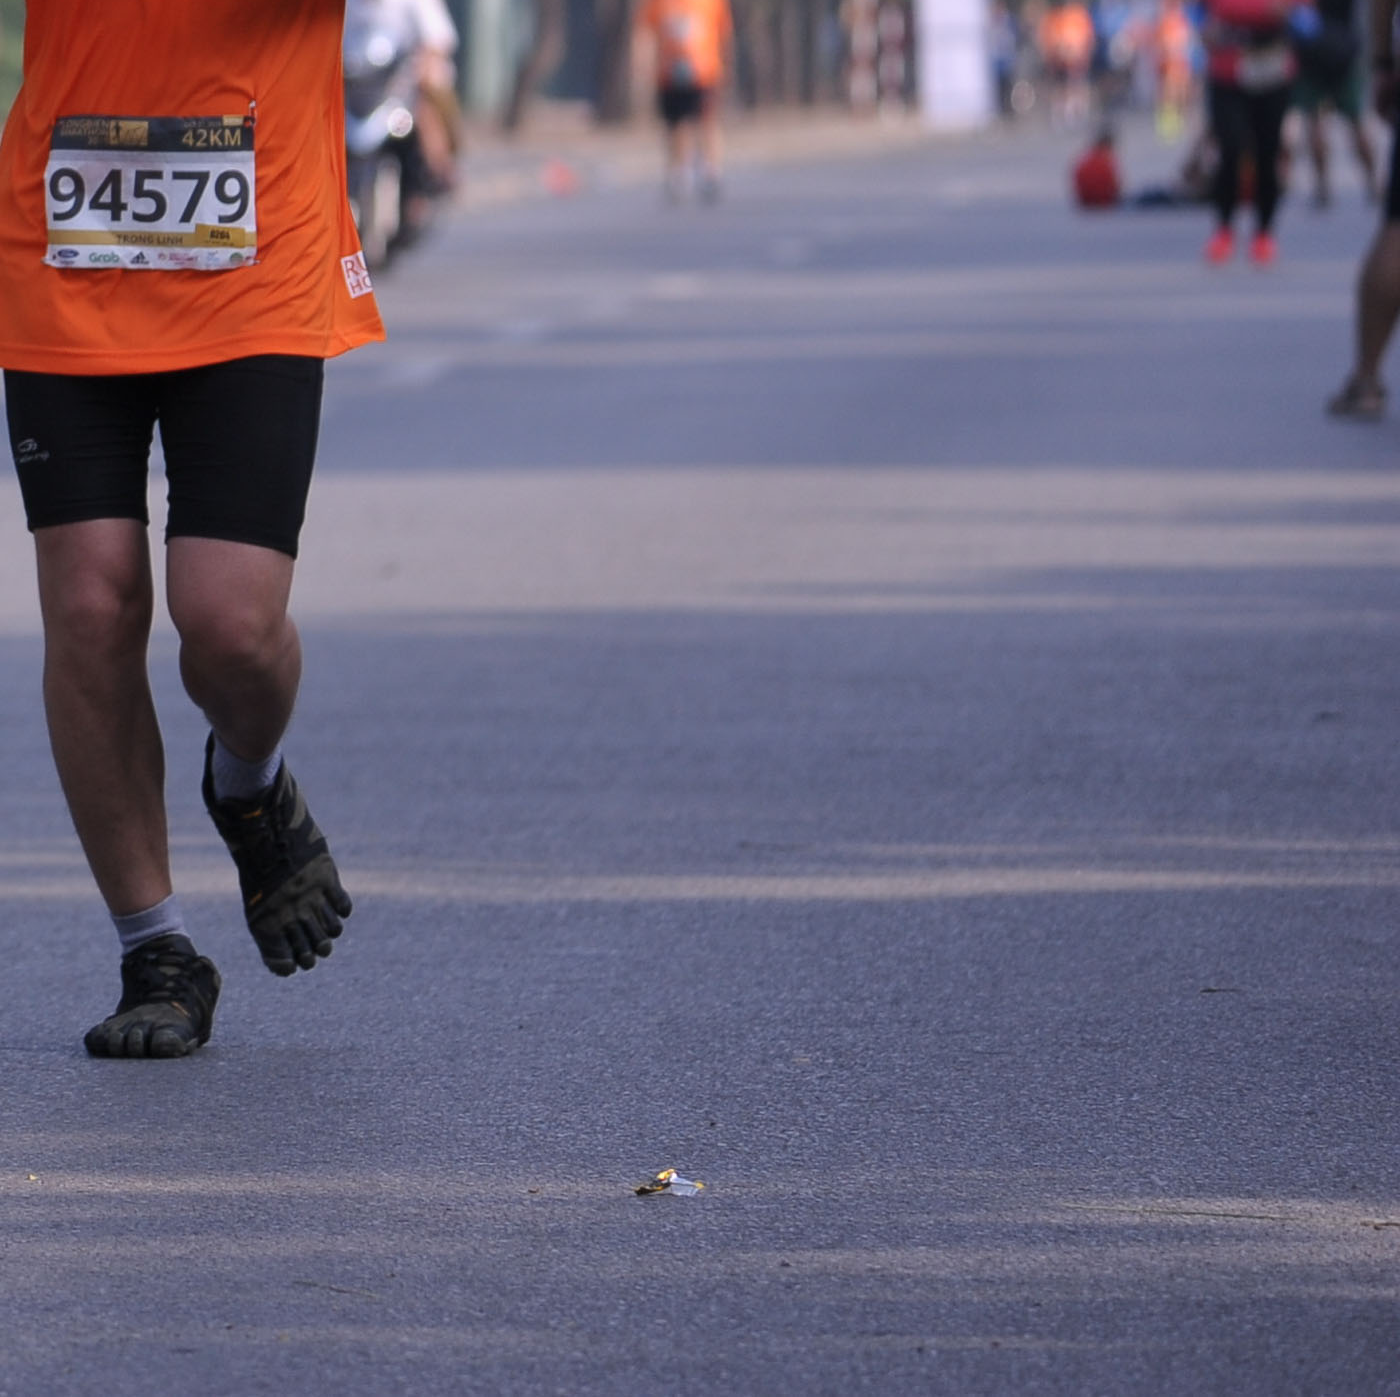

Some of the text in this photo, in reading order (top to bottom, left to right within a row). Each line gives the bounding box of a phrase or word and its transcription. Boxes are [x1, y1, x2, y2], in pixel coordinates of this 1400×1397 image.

[182, 128, 241, 147] 42KM
[49, 167, 250, 224] 94579
[88, 250, 120, 263] Grab
